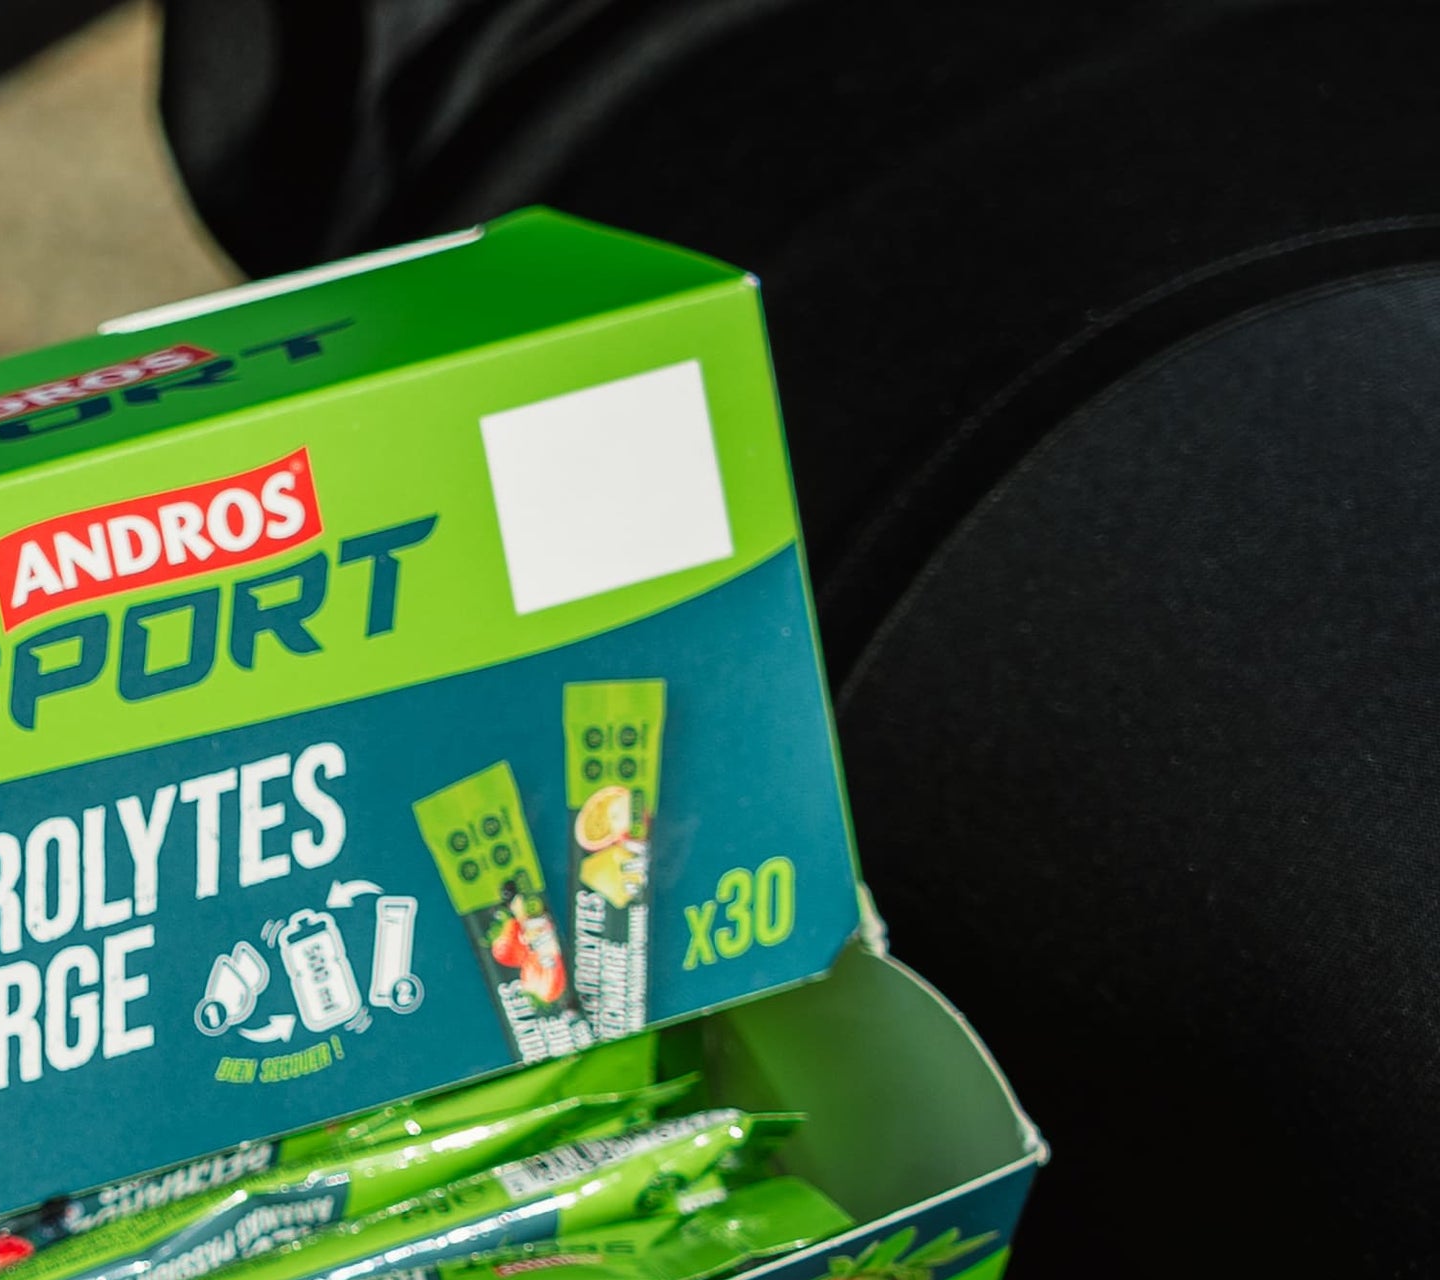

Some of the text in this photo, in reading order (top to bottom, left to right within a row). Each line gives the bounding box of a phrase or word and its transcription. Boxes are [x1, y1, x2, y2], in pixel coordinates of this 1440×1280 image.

[10, 470, 307, 609] ANDROS
[682, 856, 797, 971] x30
[395, 977, 414, 1006] 2
[204, 1002, 221, 1028] 1
[260, 1041, 333, 1083] SECOUER
